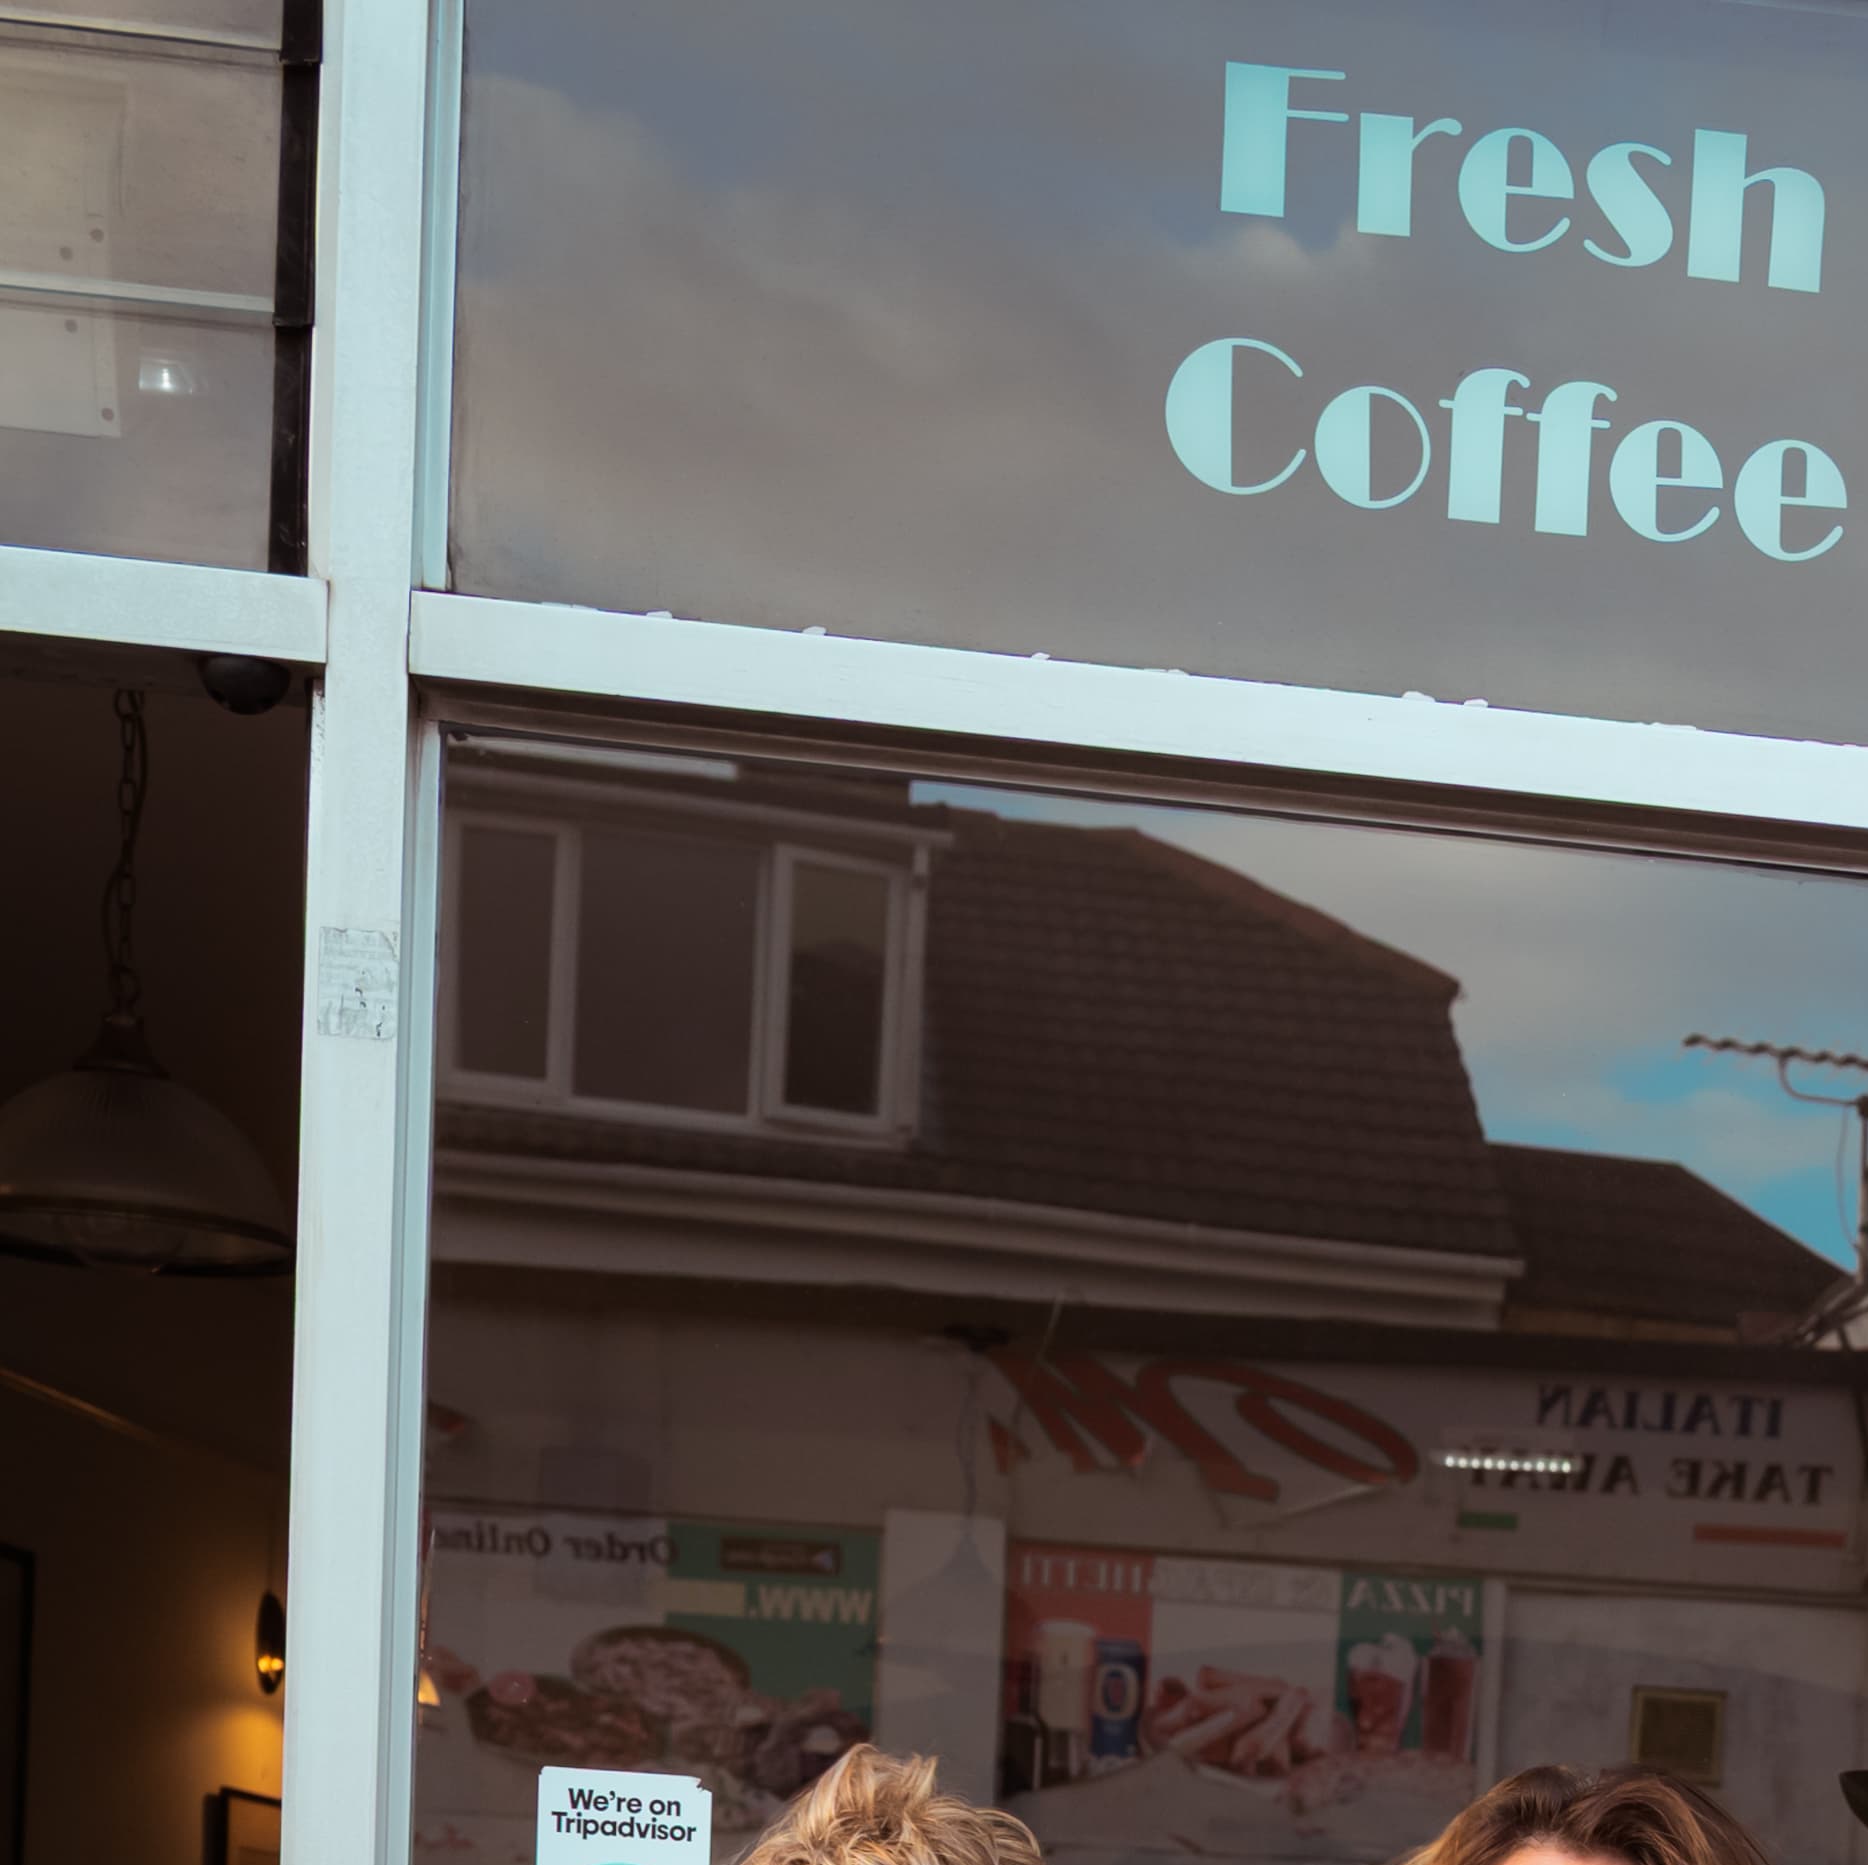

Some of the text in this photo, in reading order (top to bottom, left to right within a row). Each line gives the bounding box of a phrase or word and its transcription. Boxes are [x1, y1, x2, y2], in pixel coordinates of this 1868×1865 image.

[1219, 58, 1828, 294] Fresh
[1163, 336, 1851, 564] Coffee
[551, 1811, 697, 1842] Tripadvisor
[568, 1788, 681, 1817] We're on
